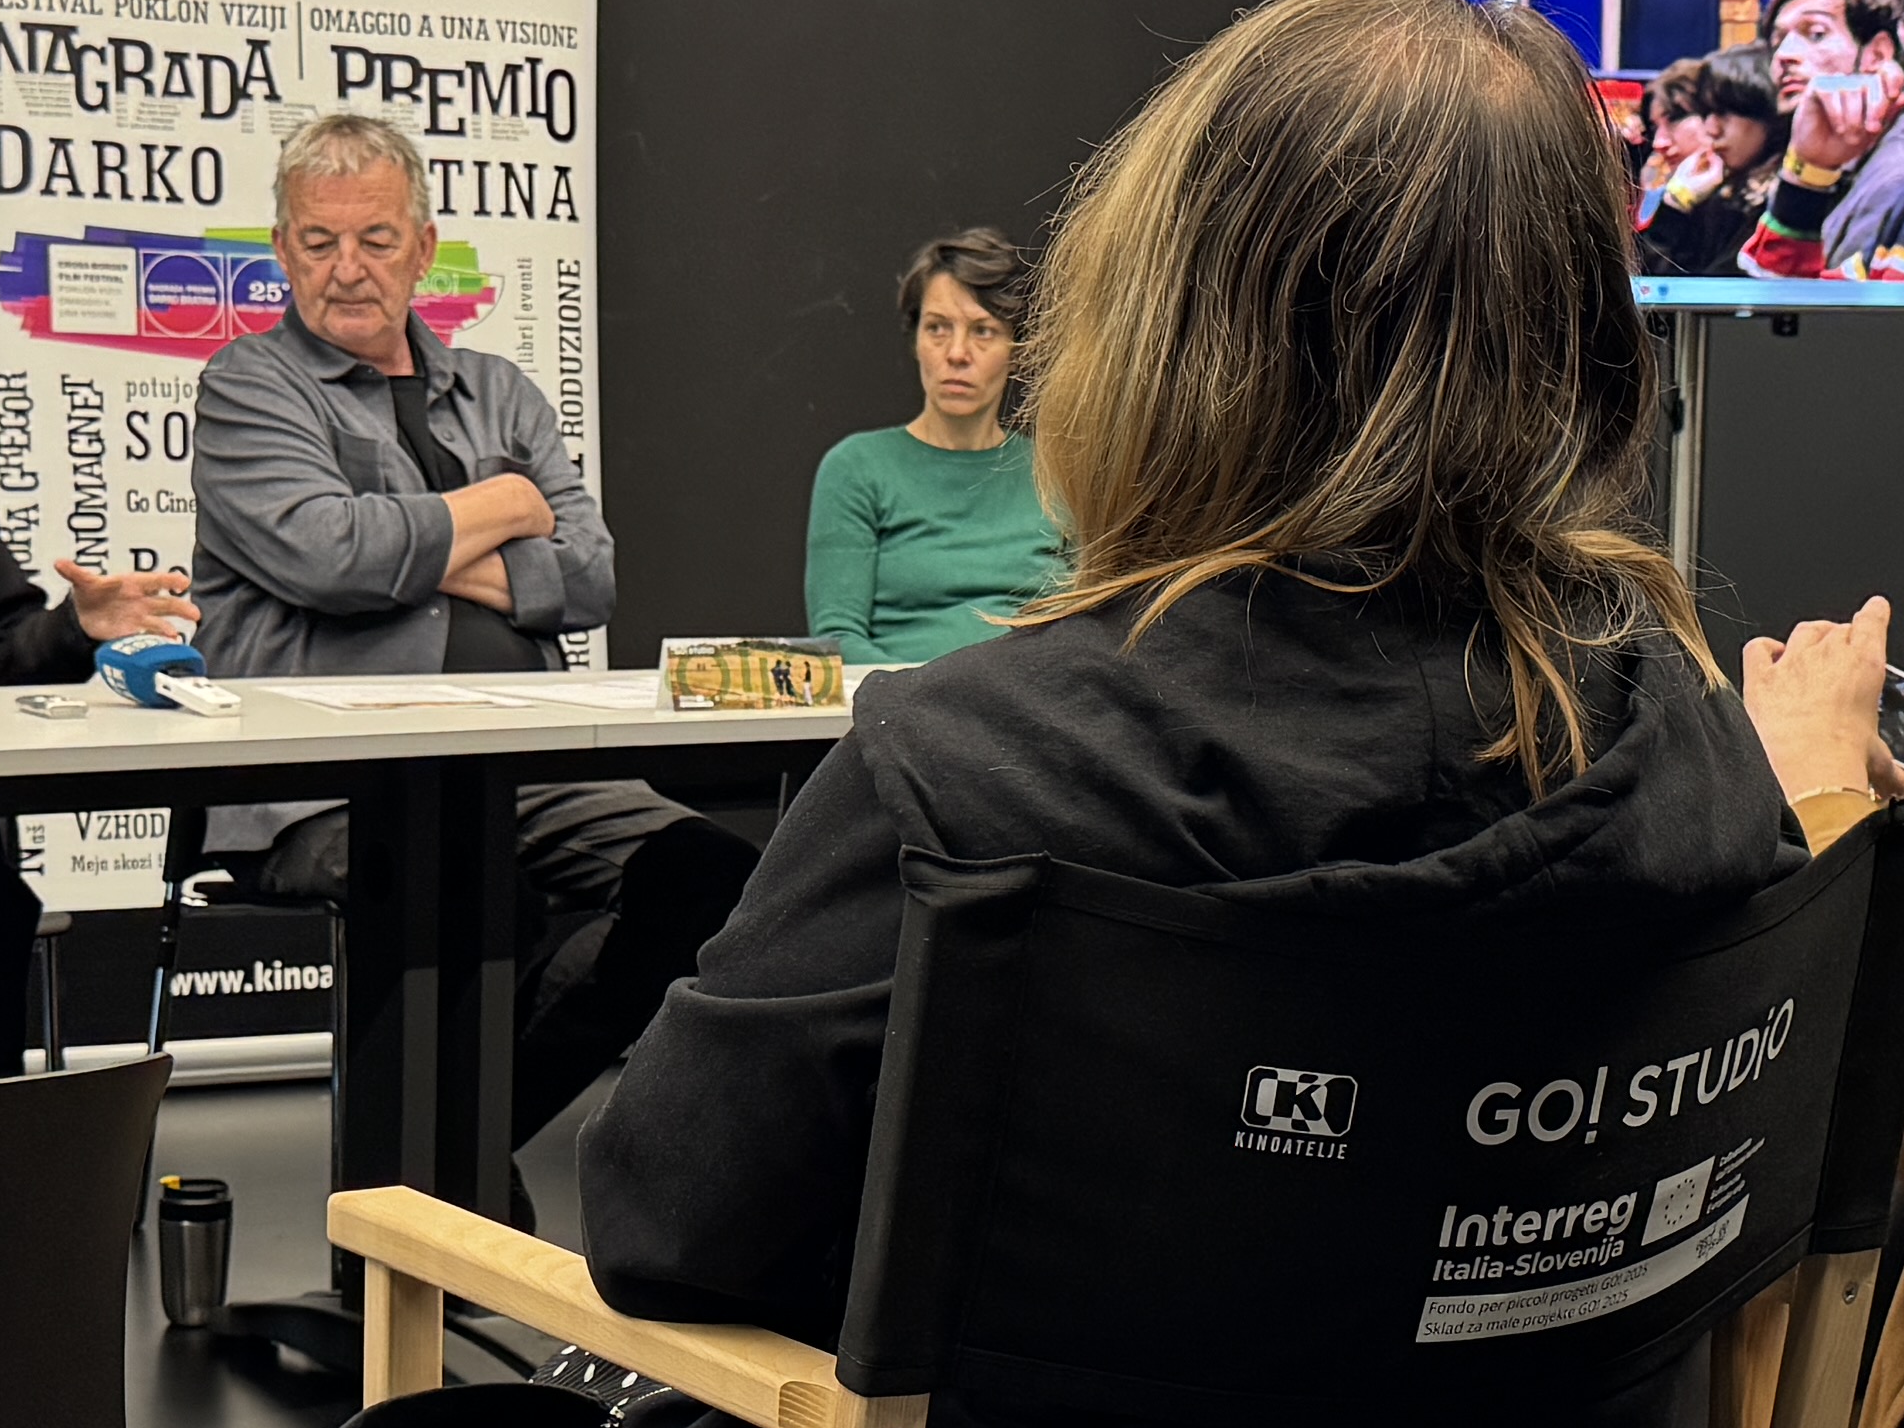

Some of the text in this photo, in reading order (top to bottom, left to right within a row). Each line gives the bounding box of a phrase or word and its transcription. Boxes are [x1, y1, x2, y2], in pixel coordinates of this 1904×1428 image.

[220, 1, 288, 33] VIZIJI
[309, 6, 579, 50] OMAGGIO A UNA VISIONE
[330, 43, 577, 144] PREMIO
[427, 157, 580, 223] TINA
[125, 376, 202, 404] potujo
[59, 373, 110, 576] INOMAGNET
[125, 489, 150, 514] Go
[75, 813, 166, 841] VZHOD
[71, 854, 109, 876] Meja
[113, 853, 153, 871] skozi
[1466, 1065, 1609, 1147] GO!
[1234, 1130, 1349, 1161] KINOATELJE
[1438, 1190, 1639, 1249] Interreg
[1432, 1236, 1626, 1283] Italia-Slovenija
[1428, 1300, 1476, 1316] Fondo
[1478, 1299, 1506, 1317] per
[1505, 1291, 1549, 1312] piccoli
[1549, 1281, 1598, 1307] progetti
[1423, 1319, 1464, 1337] Sklad
[1466, 1322, 1484, 1335] za
[1486, 1315, 1521, 1331] male
[1522, 1307, 1577, 1330] projekte
